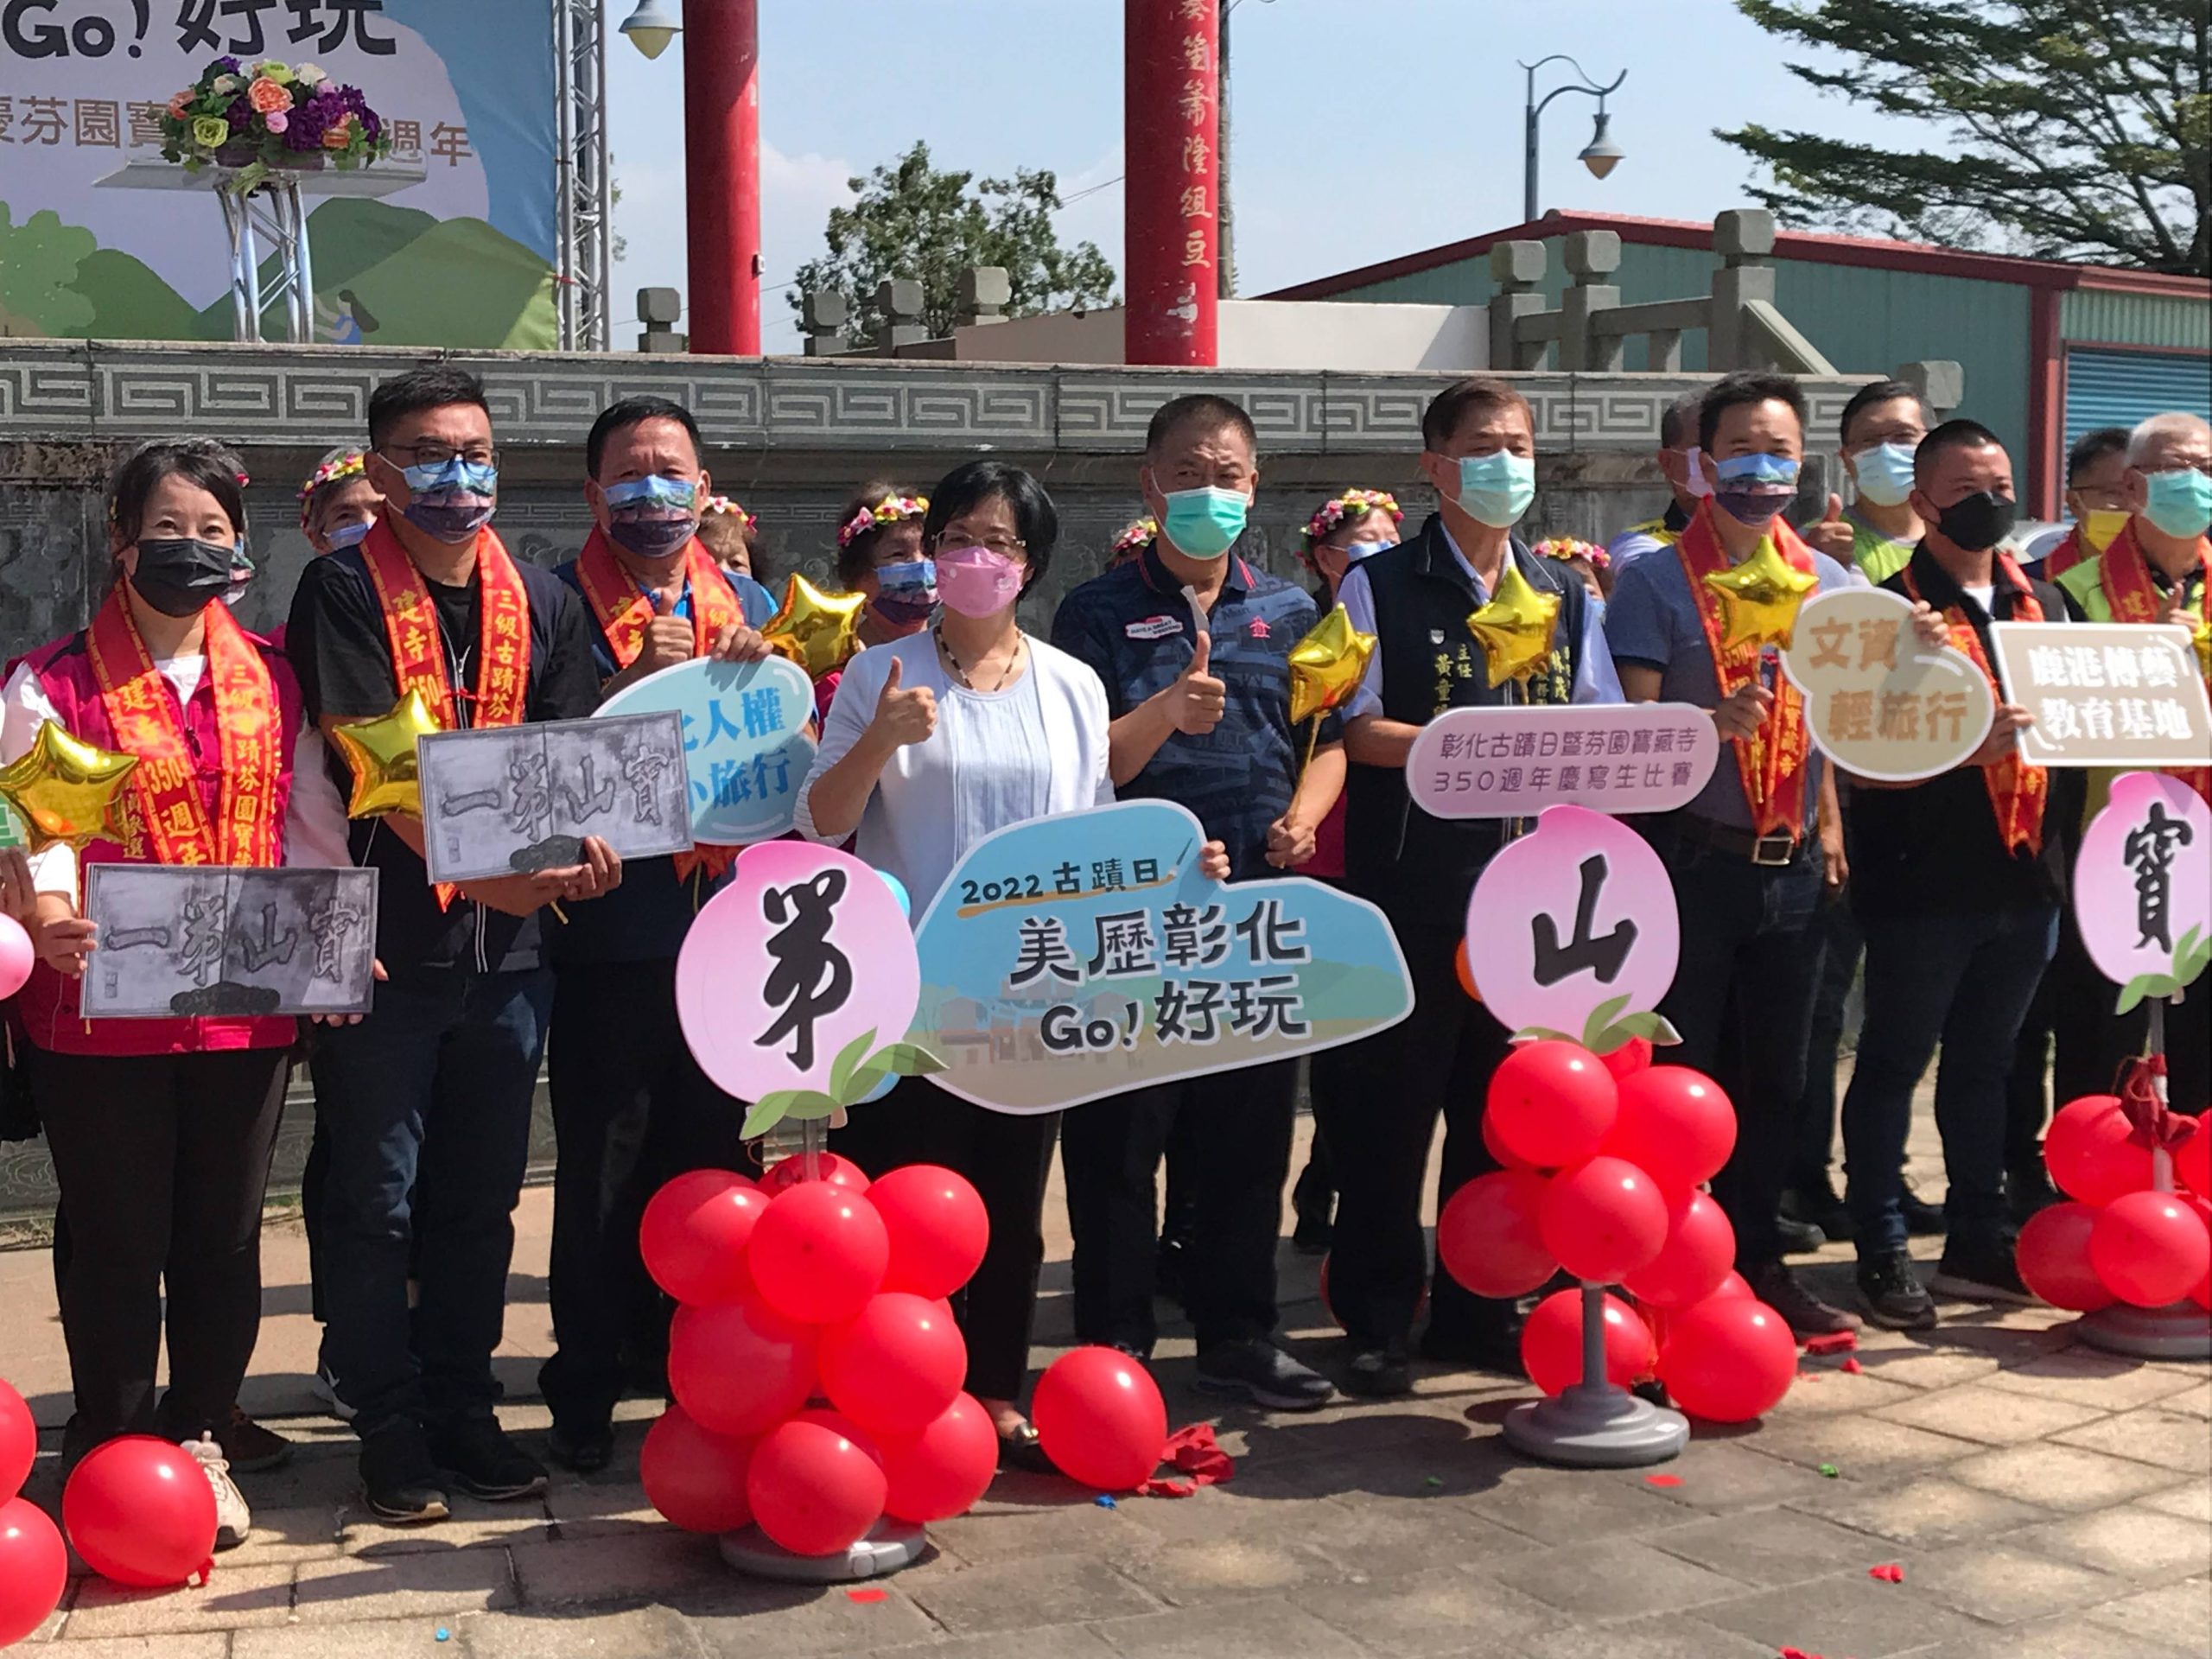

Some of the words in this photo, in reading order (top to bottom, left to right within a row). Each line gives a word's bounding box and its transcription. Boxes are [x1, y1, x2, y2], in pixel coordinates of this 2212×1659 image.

[3, 0, 149, 58] Go!
[0, 96, 168, 149] 芬園寶
[482, 590, 520, 728] 三級古蹟芬
[1808, 616, 1899, 671] 文資
[1827, 689, 1968, 742] 輕旅行
[2041, 697, 2194, 741] 教育基地
[1008, 899, 1307, 987] 美歷彰化
[1530, 852, 1640, 988] 山
